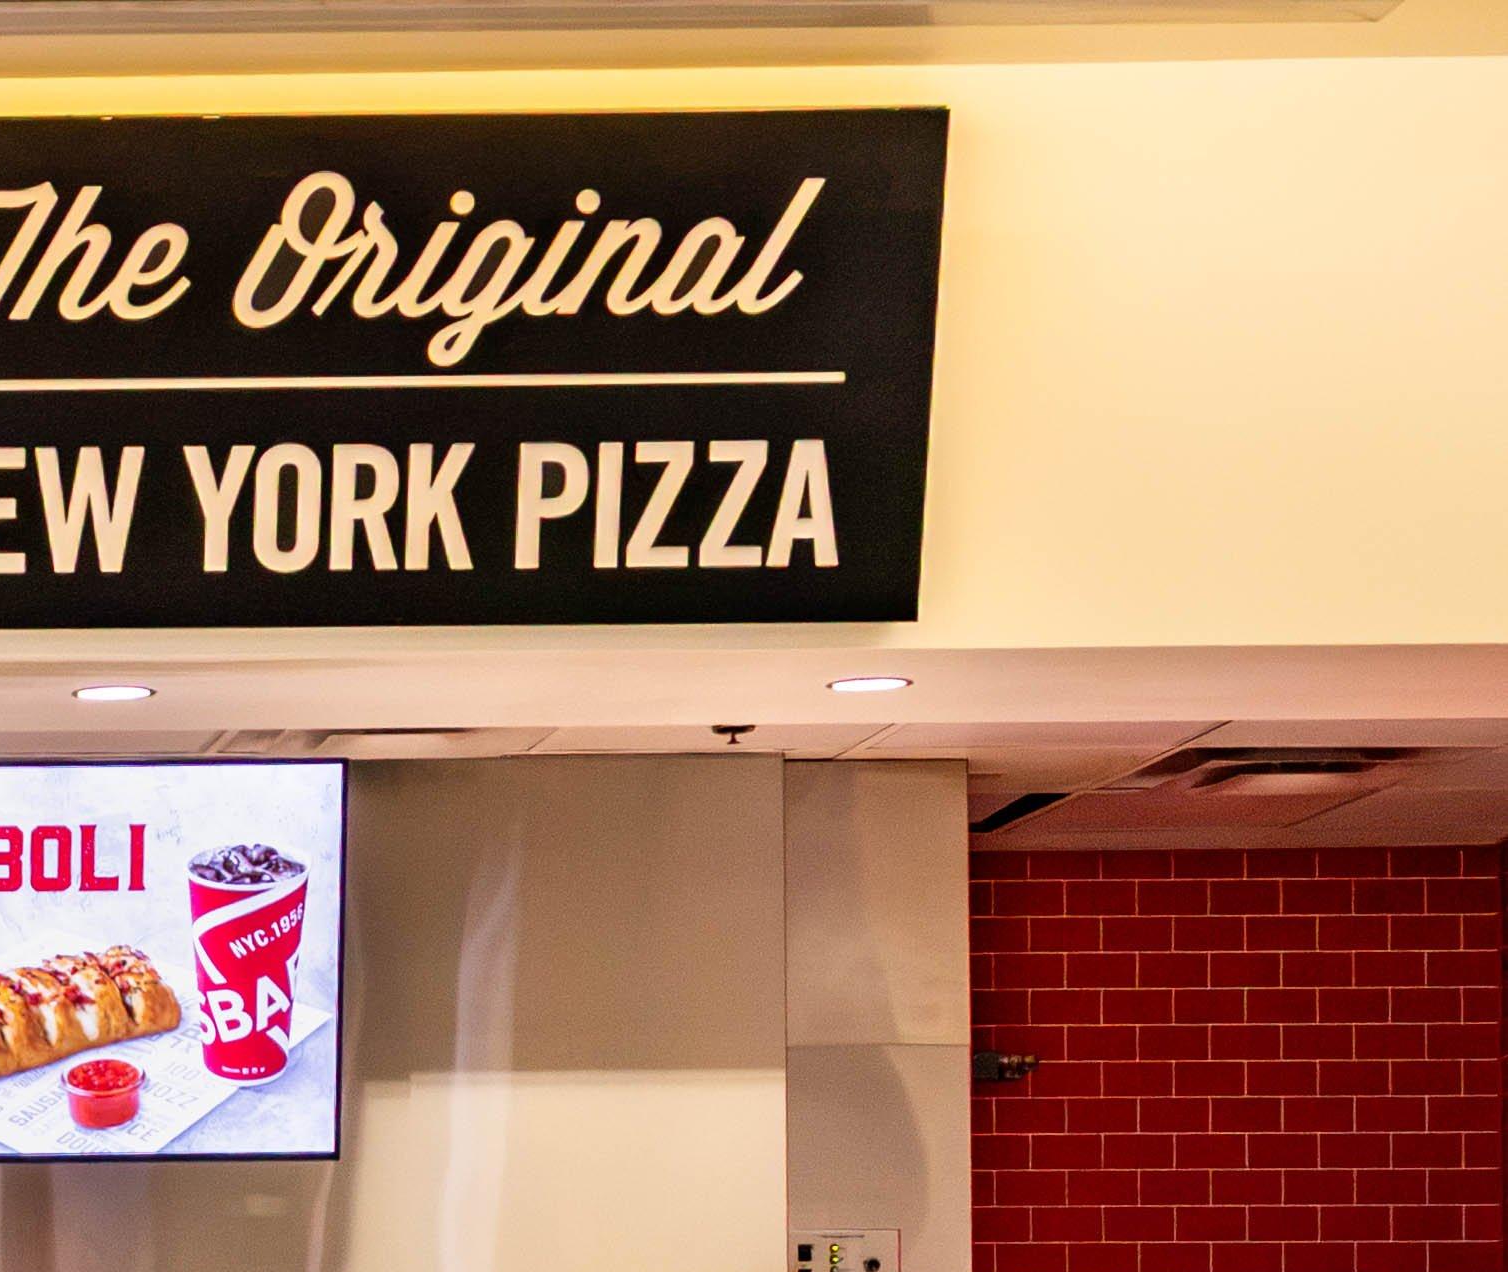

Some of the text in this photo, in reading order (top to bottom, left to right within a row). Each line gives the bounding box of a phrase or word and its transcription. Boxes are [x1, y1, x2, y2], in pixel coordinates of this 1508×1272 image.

[232, 169, 826, 367] Original
[184, 442, 473, 573] YORK
[514, 439, 839, 571] PIZZA
